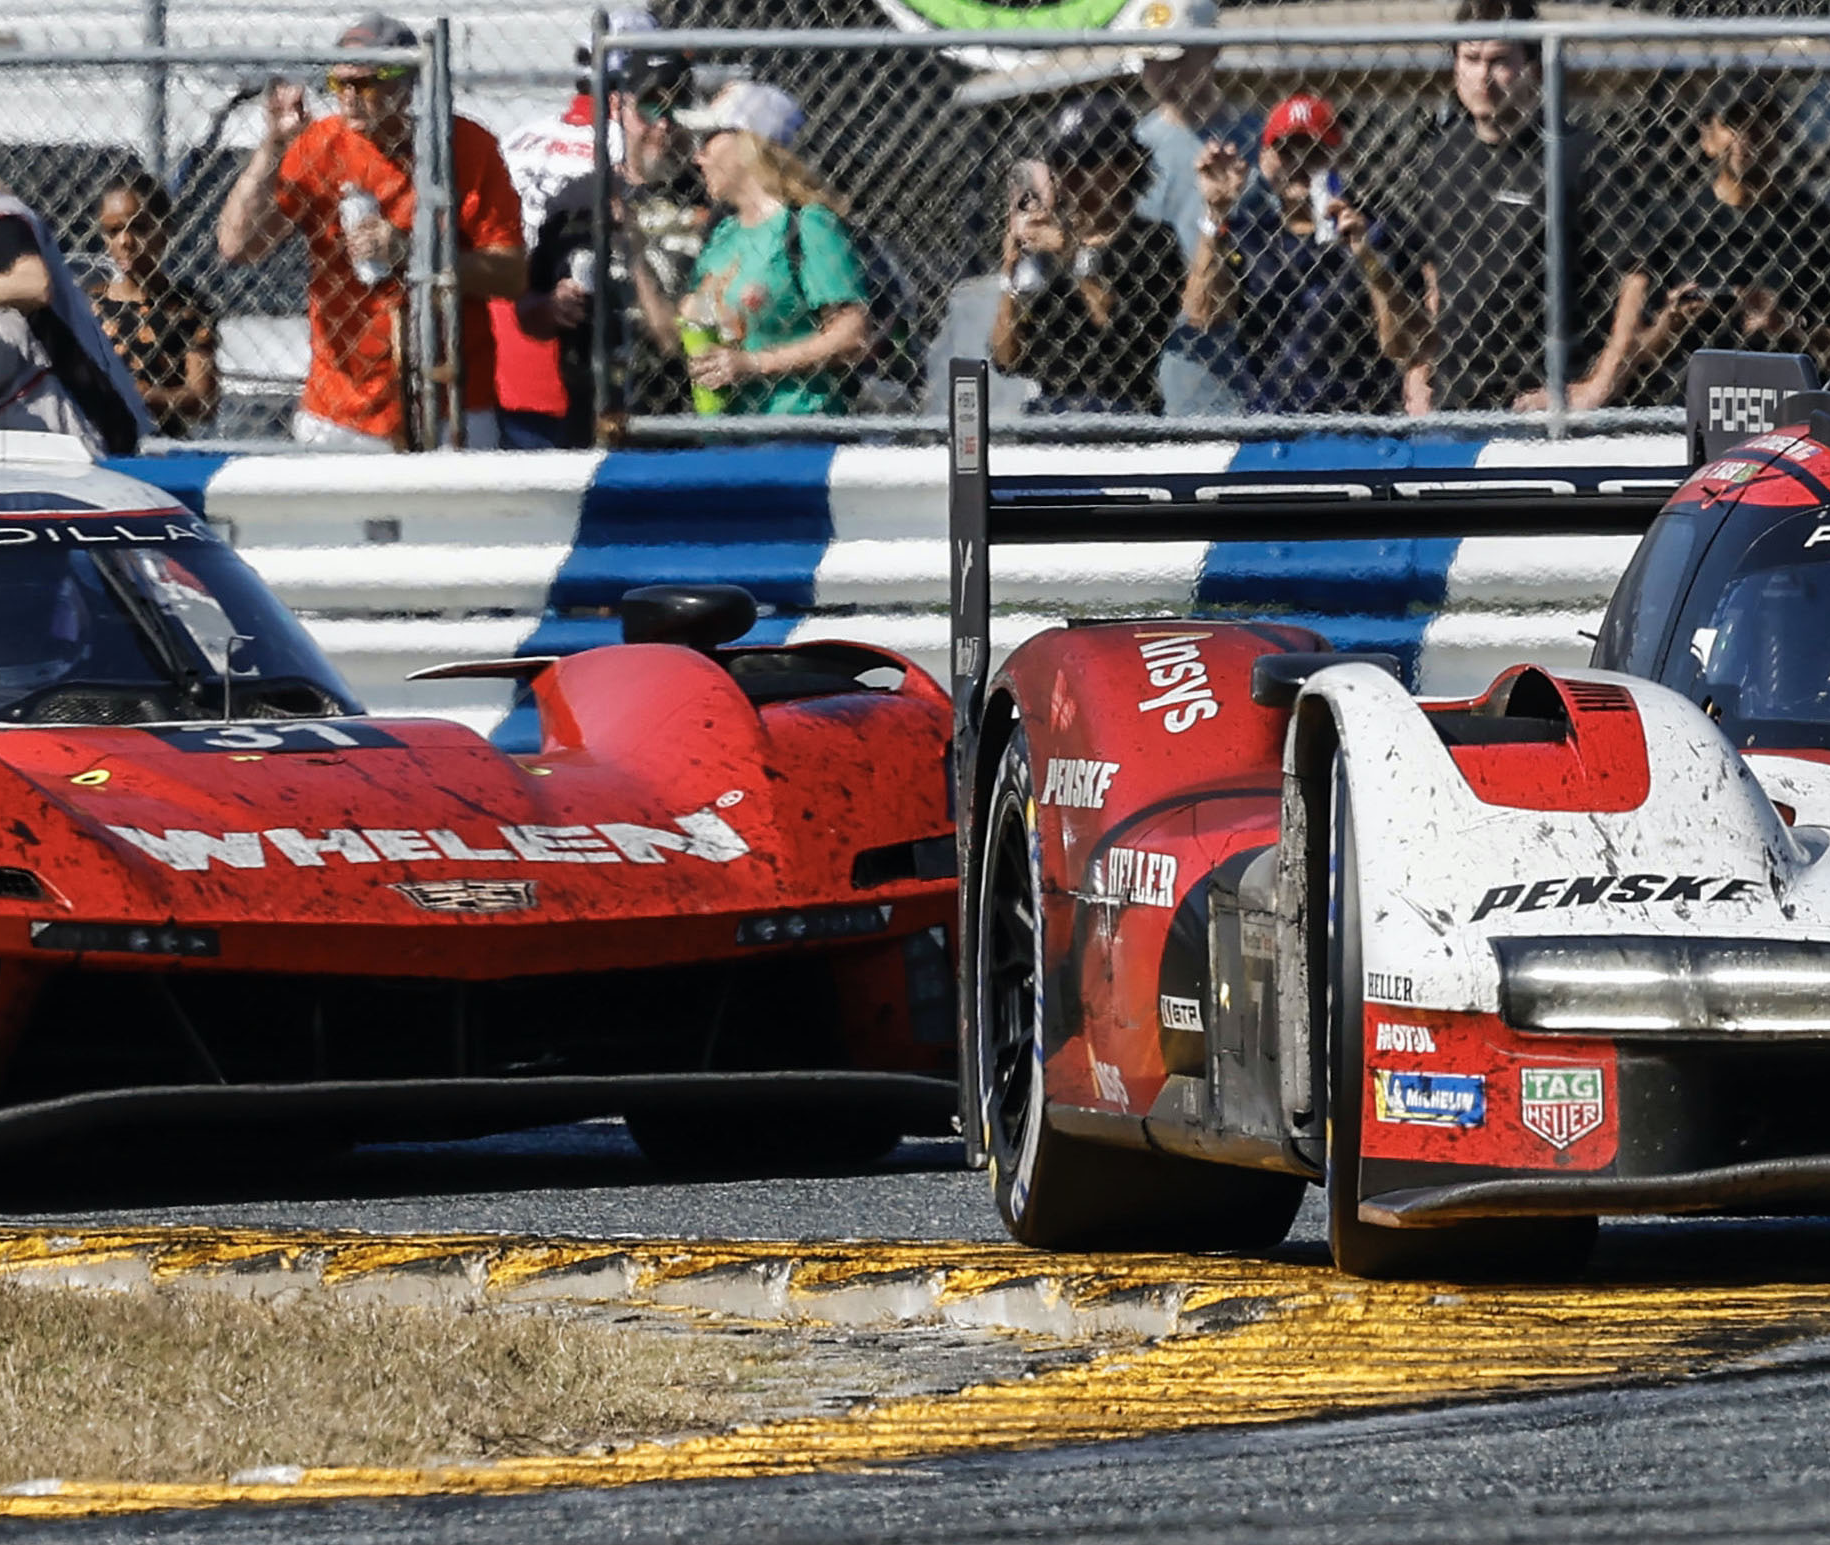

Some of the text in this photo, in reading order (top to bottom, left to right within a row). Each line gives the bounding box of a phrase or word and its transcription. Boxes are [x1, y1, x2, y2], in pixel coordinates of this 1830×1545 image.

[1134, 632, 1219, 734] Ansys
[179, 723, 359, 748] 31
[1040, 758, 1120, 809] PENSKE
[105, 806, 750, 871] WHELEN
[1108, 847, 1178, 907] HELLER
[1469, 874, 1765, 924] PENSKE
[1368, 972, 1413, 1002] HELLER
[1172, 1005, 1200, 1025] GTP
[1376, 1022, 1436, 1053] MOTUL
[1406, 1088, 1474, 1112] MICHELIN
[1529, 1075, 1595, 1098] TAG
[1527, 1104, 1597, 1142] HEUER
